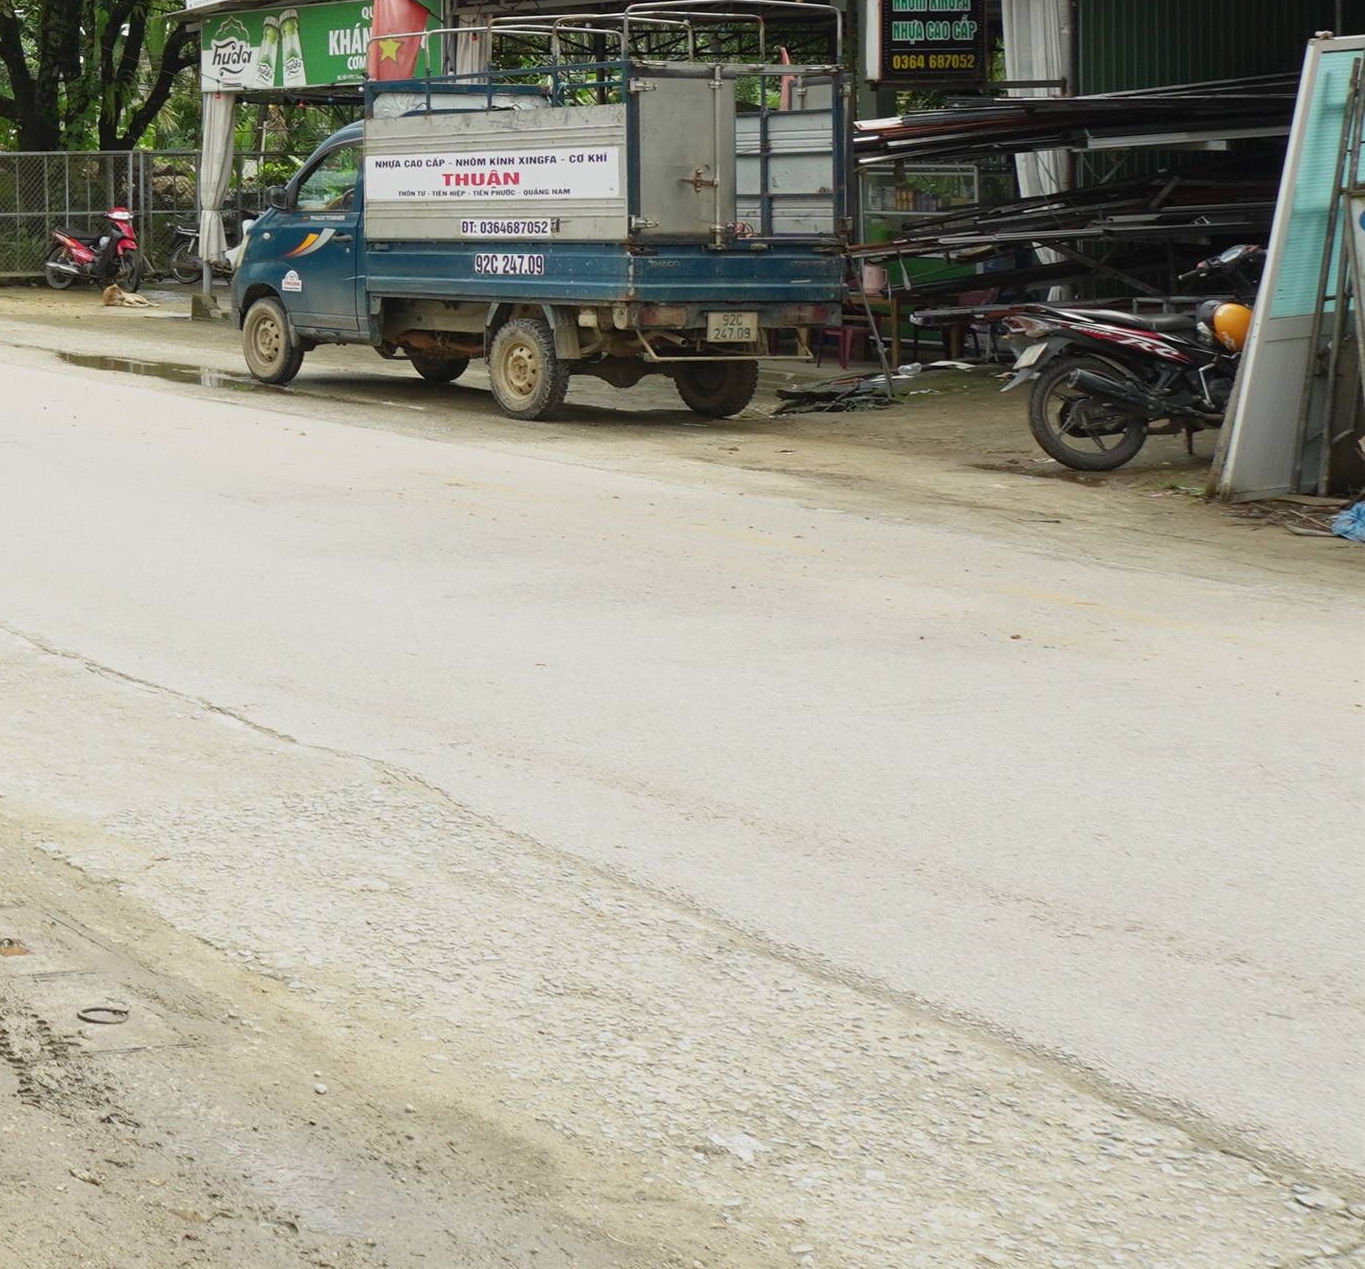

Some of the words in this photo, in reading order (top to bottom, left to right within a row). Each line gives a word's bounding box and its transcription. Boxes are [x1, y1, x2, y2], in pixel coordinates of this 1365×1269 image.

[892, 20, 925, 44] NHỰA
[926, 21, 951, 40] CAO
[953, 14, 977, 40] CẤP
[329, 23, 373, 56] KHÁN
[212, 41, 252, 66] huda
[893, 54, 925, 69] 0364
[929, 54, 974, 69] 687052
[375, 159, 401, 171] NHỰA
[404, 160, 423, 168] CAO
[426, 156, 445, 168] CẤP
[455, 155, 487, 167] NHÔM
[489, 153, 515, 166] KÍNH
[518, 155, 557, 165] XINGFA
[569, 153, 585, 163] CƠ
[588, 152, 607, 163] KHÍ
[442, 170, 520, 189] THUẬN
[398, 188, 416, 197] THÔN
[432, 188, 448, 197] TIÊN
[473, 187, 489, 196] TIÊN
[552, 187, 571, 195] NAM
[461, 222, 477, 234] ĐT:
[480, 221, 548, 234] 0364687052
[475, 255, 498, 274] 92C
[502, 255, 543, 275] 247.09
[722, 314, 743, 326] 92C
[713, 327, 751, 340] 247.09
